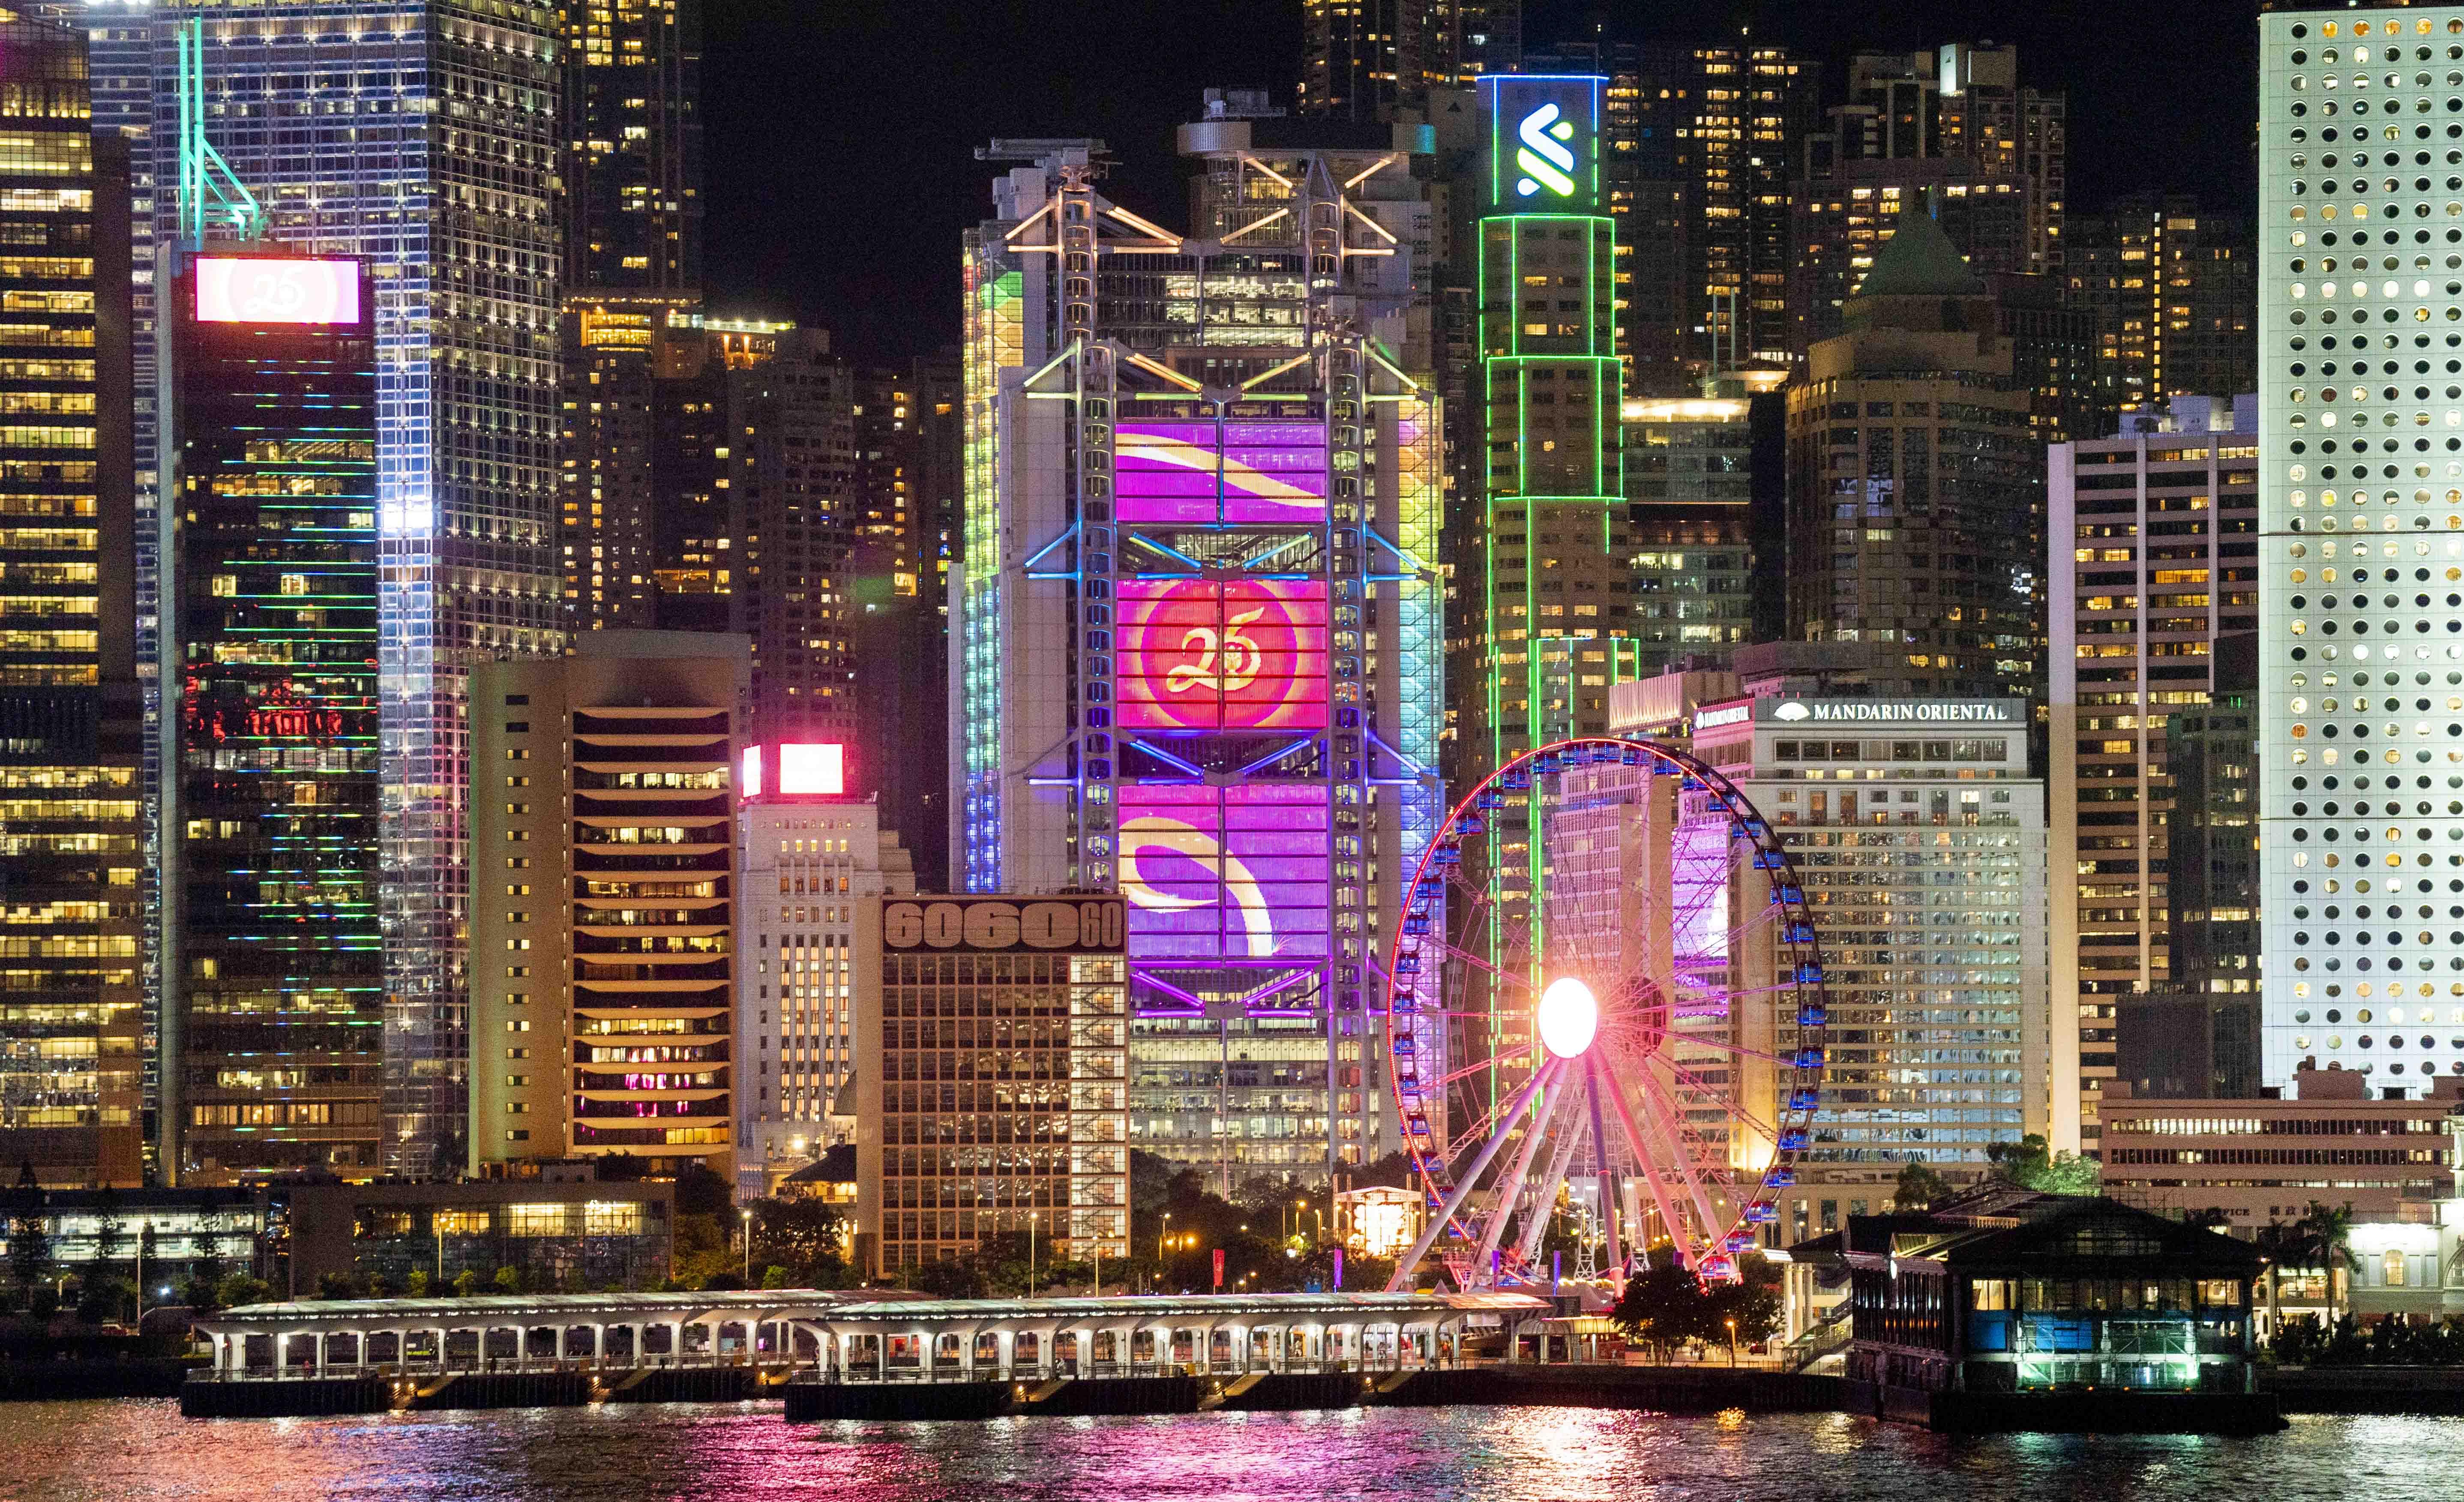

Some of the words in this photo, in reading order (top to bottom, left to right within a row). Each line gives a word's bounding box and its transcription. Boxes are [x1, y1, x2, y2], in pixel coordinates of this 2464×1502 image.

[1166, 606, 1265, 693] 25
[1814, 704, 1913, 720] MANDARIN
[1916, 704, 2008, 720] ORIENTAL
